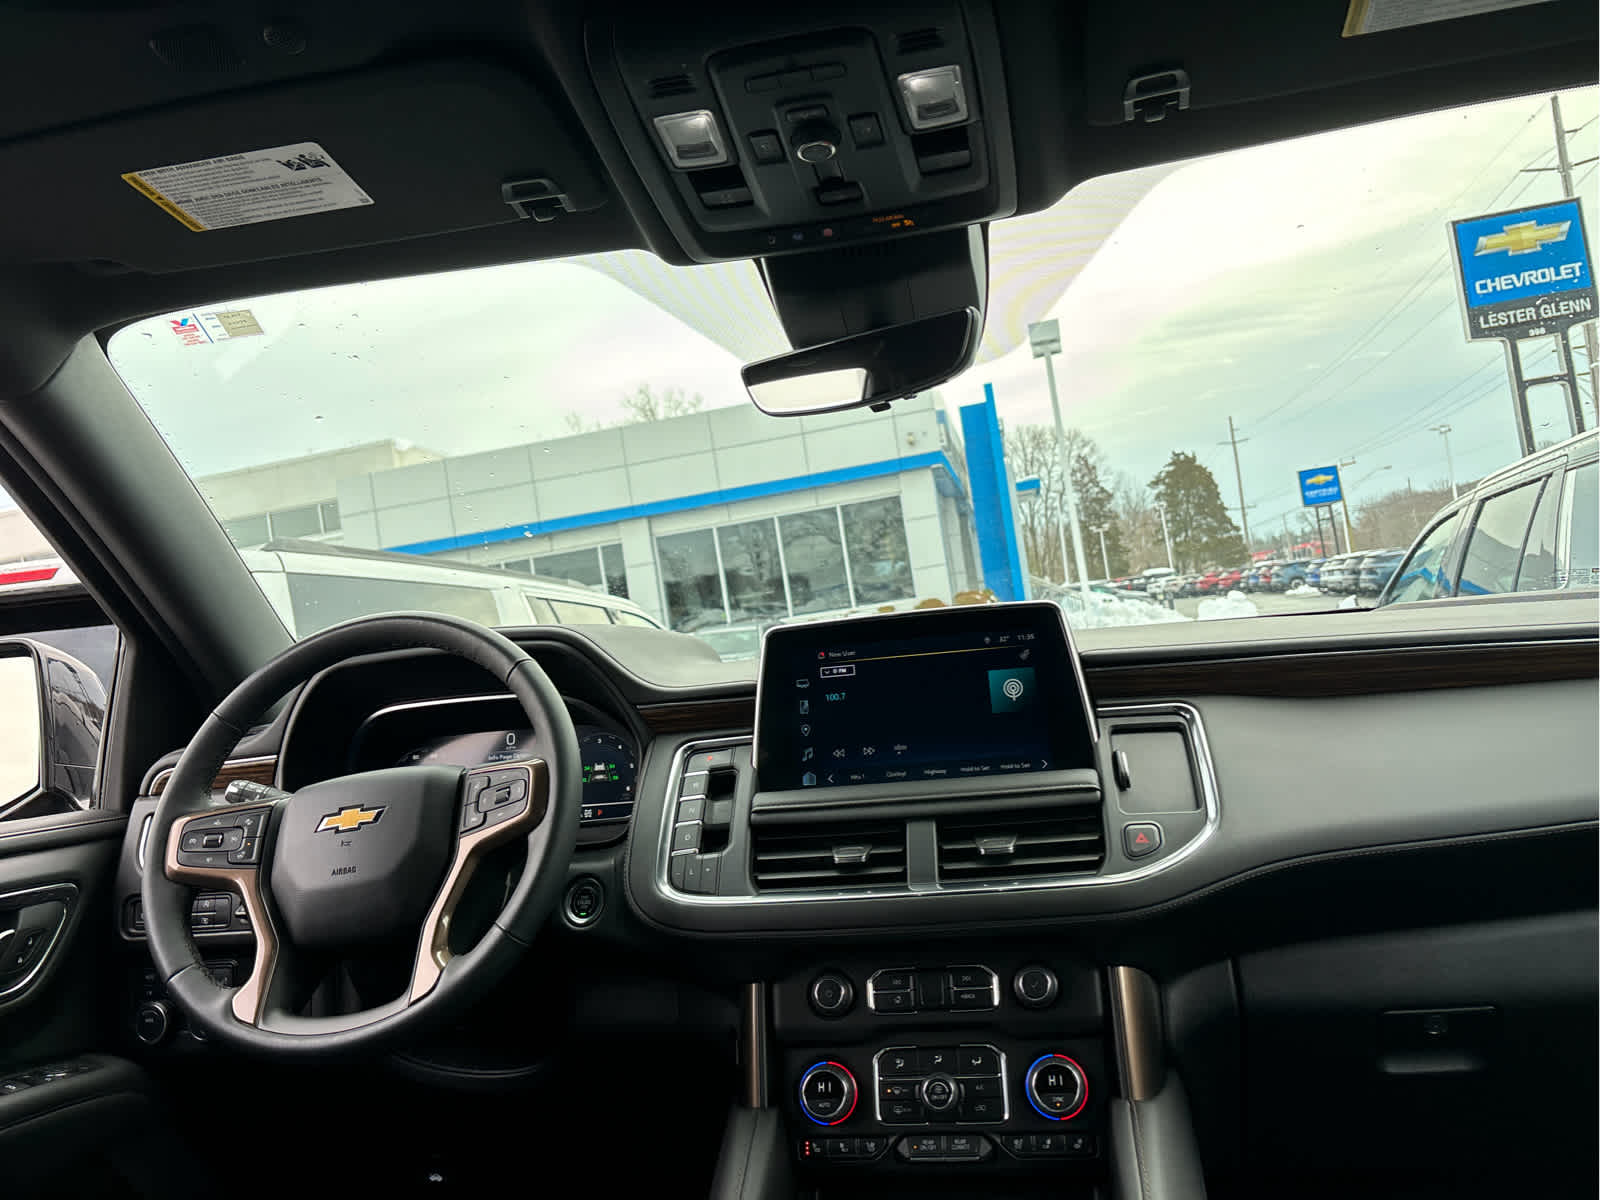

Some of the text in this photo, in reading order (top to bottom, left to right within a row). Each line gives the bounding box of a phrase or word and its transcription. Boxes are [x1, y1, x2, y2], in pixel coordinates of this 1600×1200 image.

[1474, 262, 1583, 295] CHEVROLET
[1480, 297, 1592, 329] LESTER GLENN
[825, 692, 846, 702] 100.7
[331, 865, 357, 876] AIRBAG
